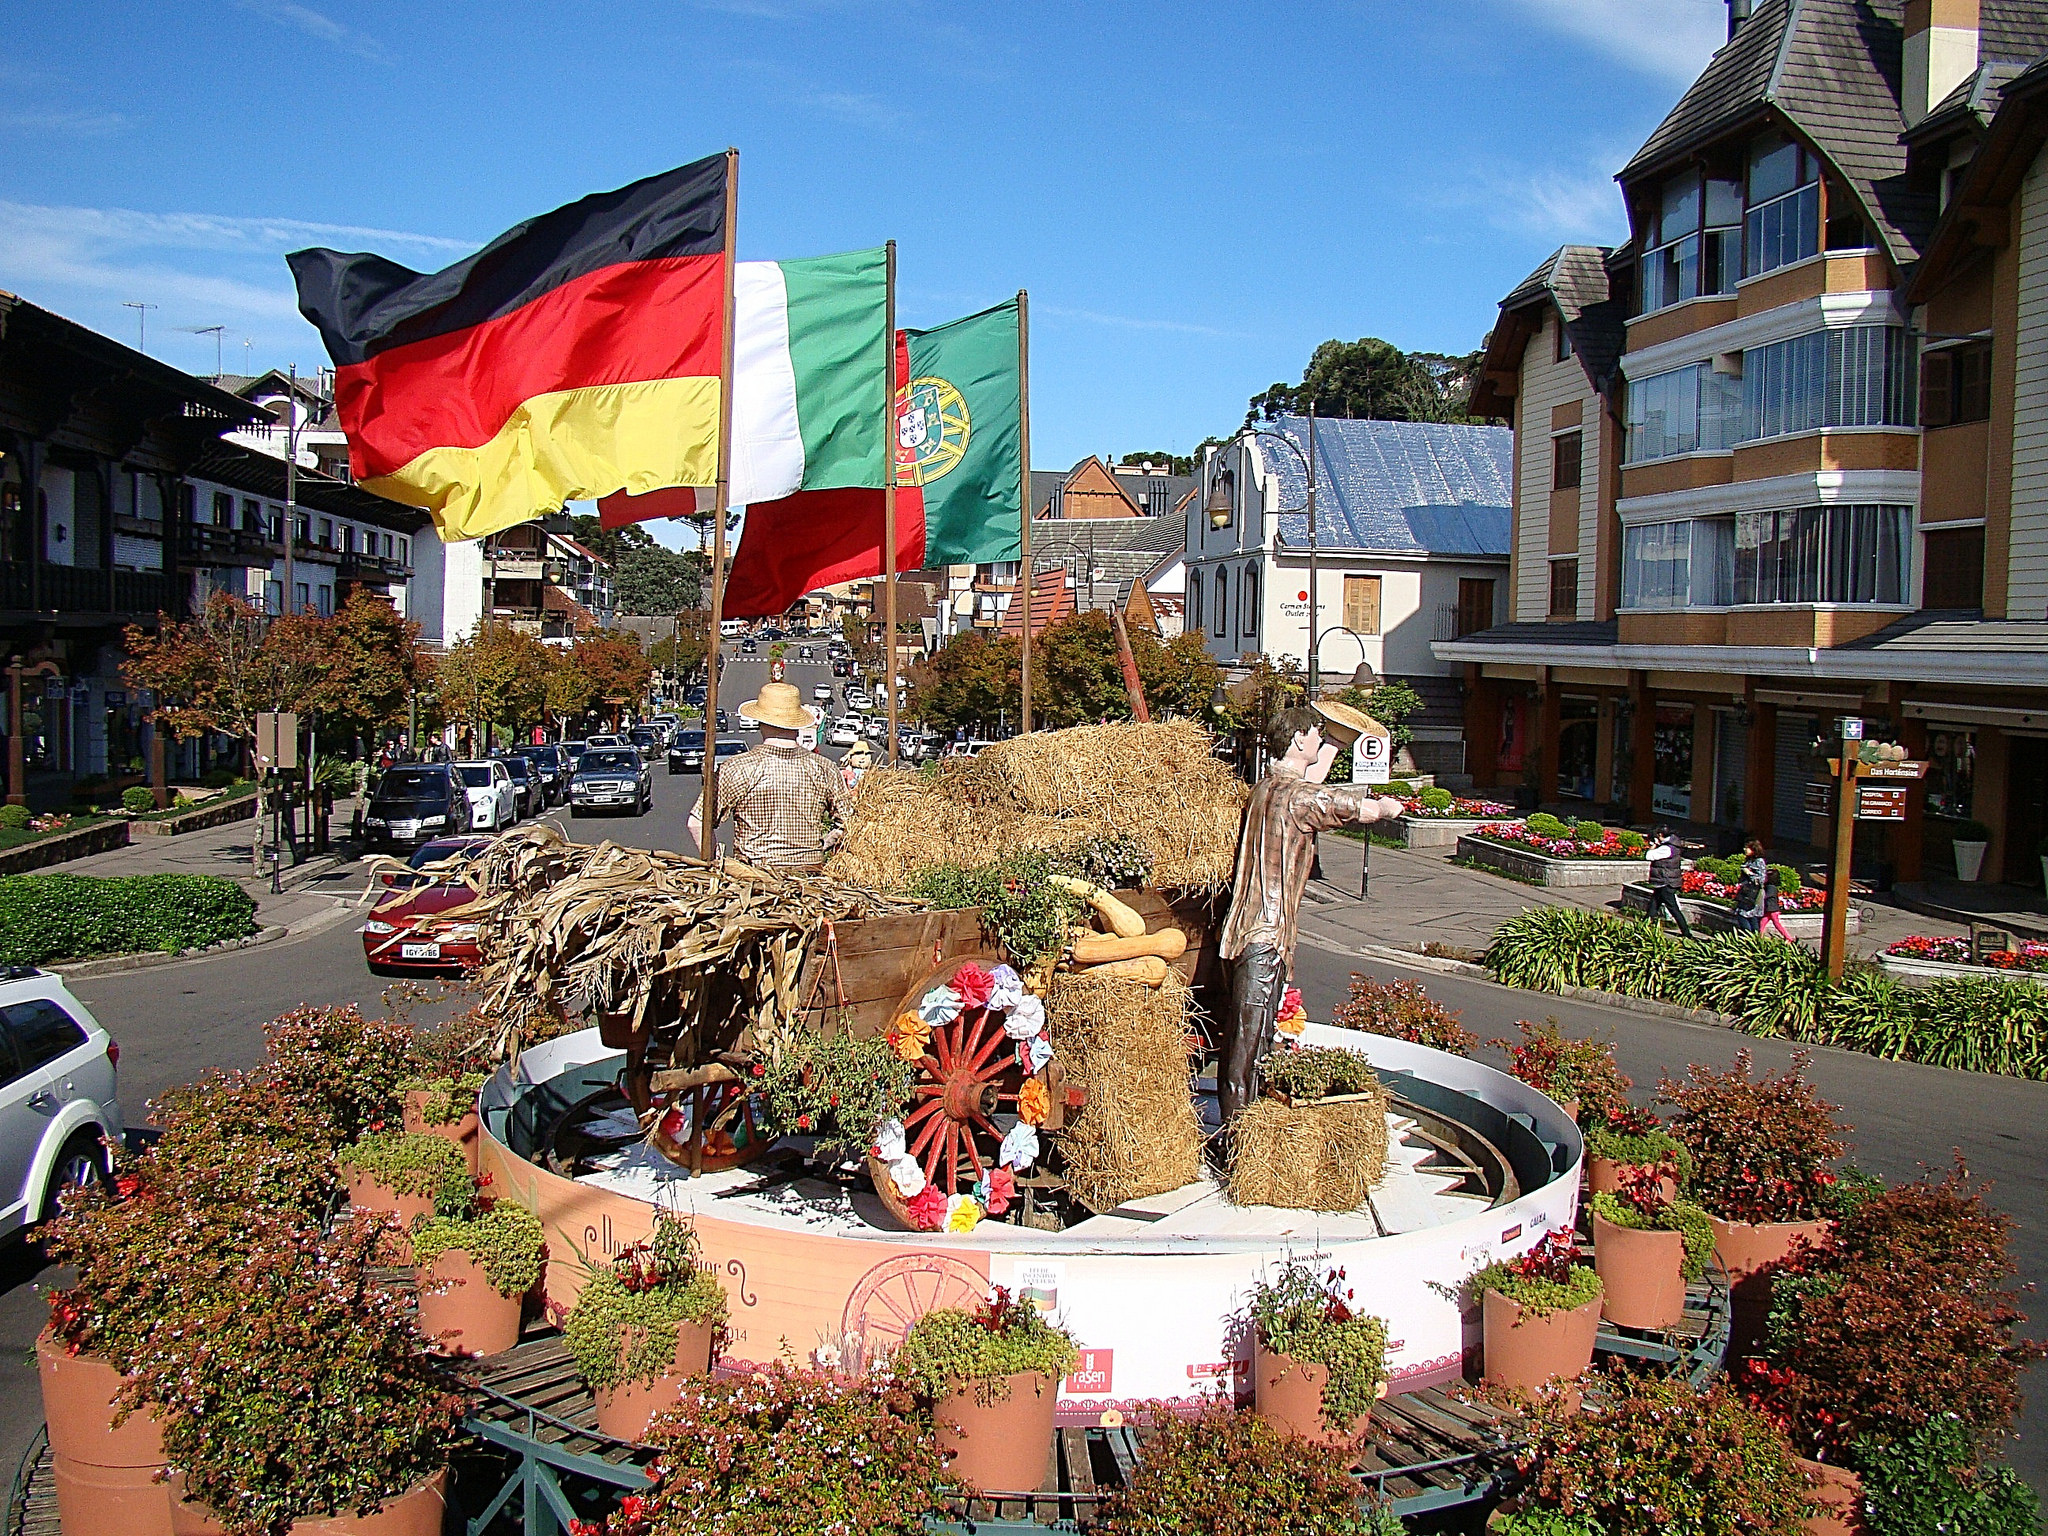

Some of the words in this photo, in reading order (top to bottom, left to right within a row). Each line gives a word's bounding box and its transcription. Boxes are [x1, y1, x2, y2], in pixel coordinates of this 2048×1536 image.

[1279, 602, 1302, 610] Carmen
[1366, 740, 1377, 756] E
[1870, 768, 1883, 776] Das
[1884, 768, 1919, 777] Hortênsias
[1530, 1212, 1547, 1228] CAIXA
